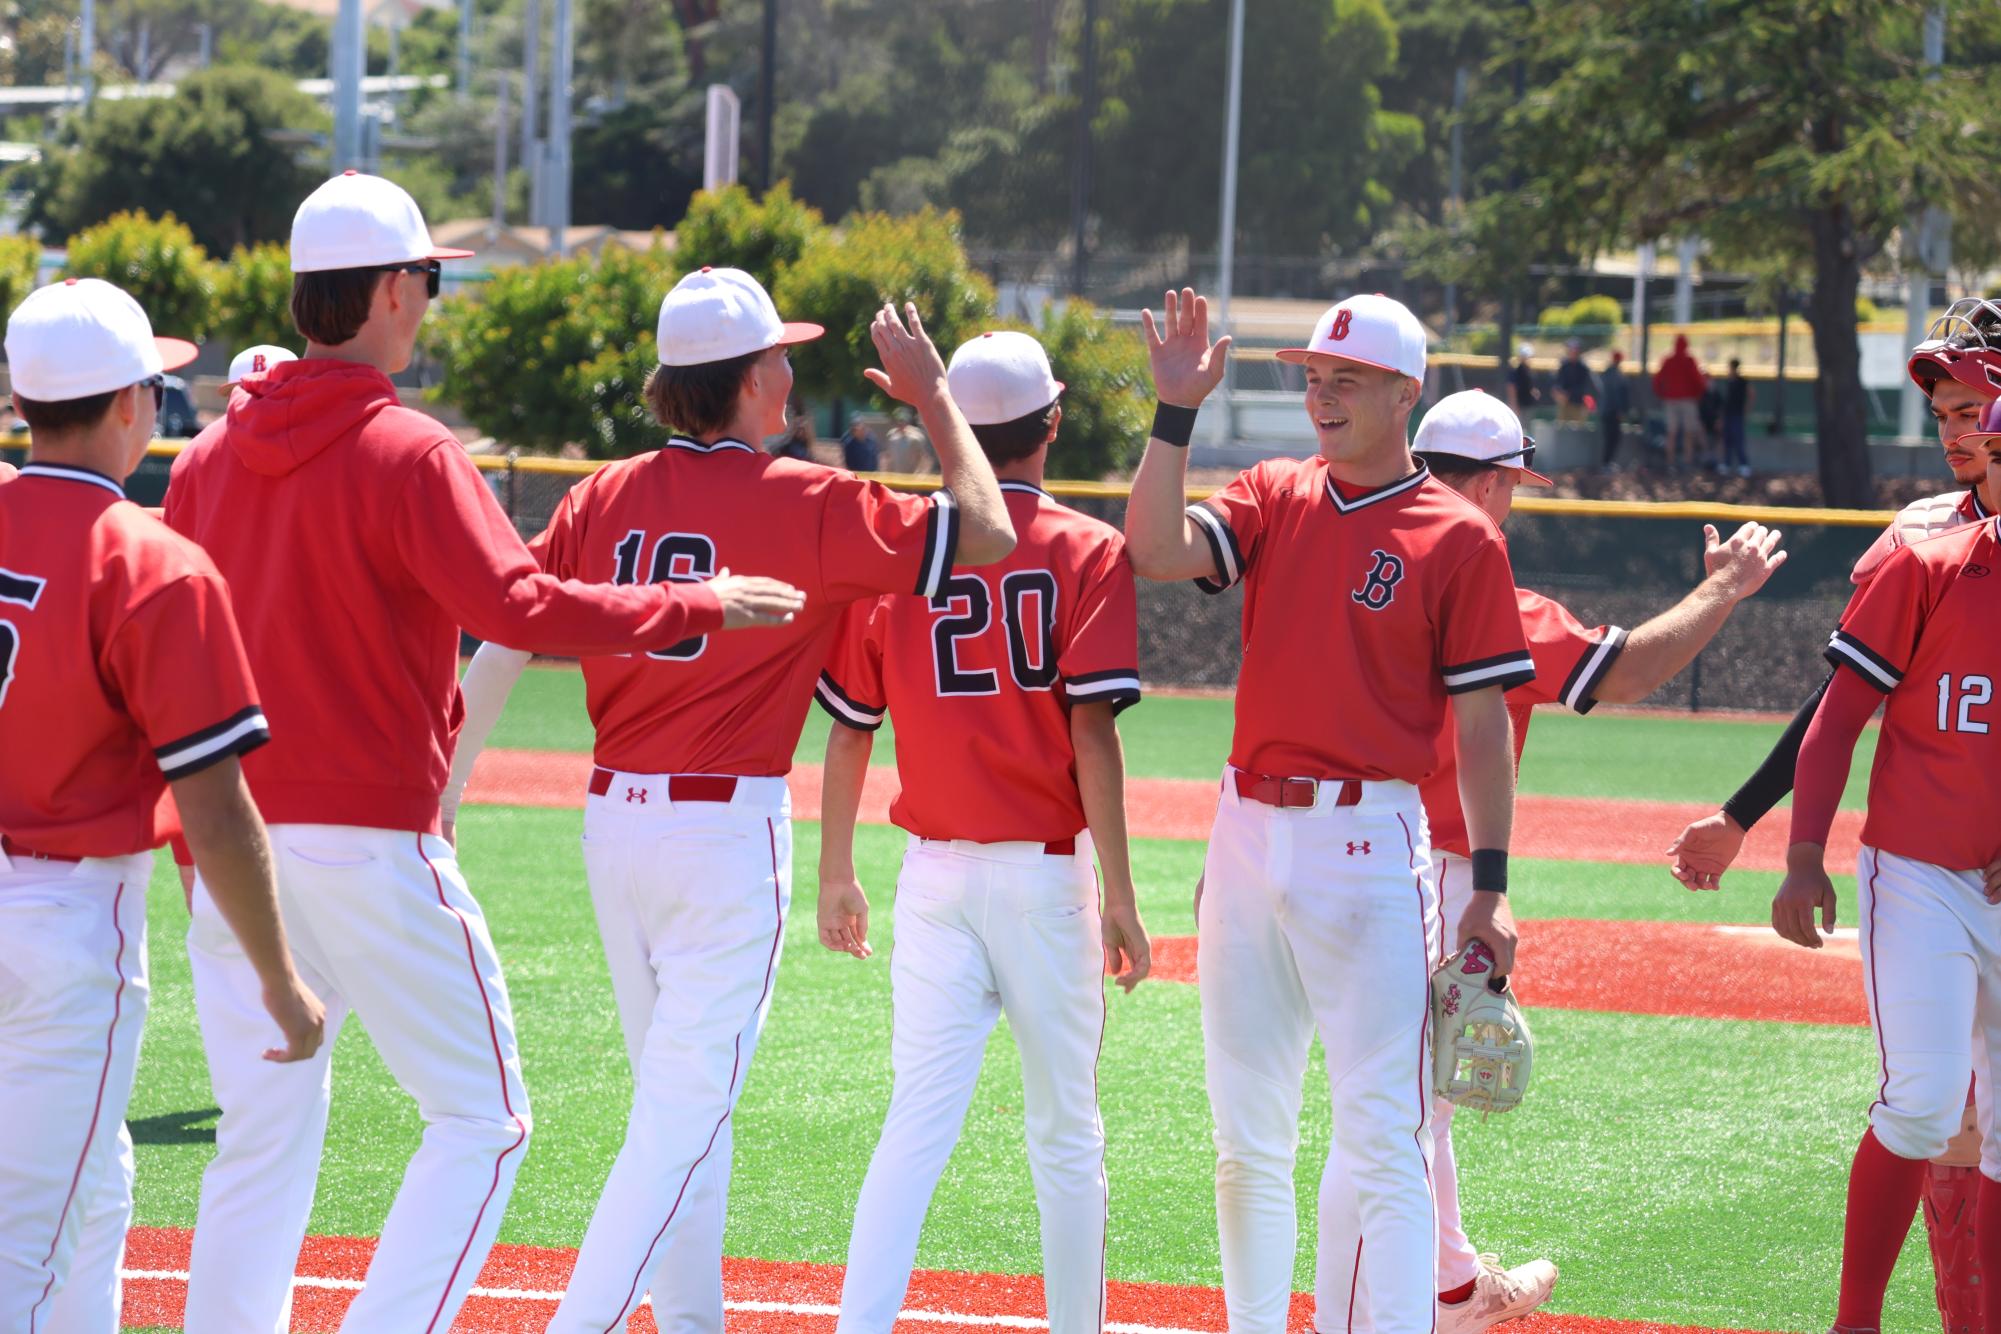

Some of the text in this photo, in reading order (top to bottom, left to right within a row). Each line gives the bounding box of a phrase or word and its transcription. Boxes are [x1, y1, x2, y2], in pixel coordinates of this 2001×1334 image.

[1328, 308, 1353, 341] B
[1351, 549, 1405, 611] B
[927, 568, 1059, 697] 20
[1937, 672, 1993, 734] 12
